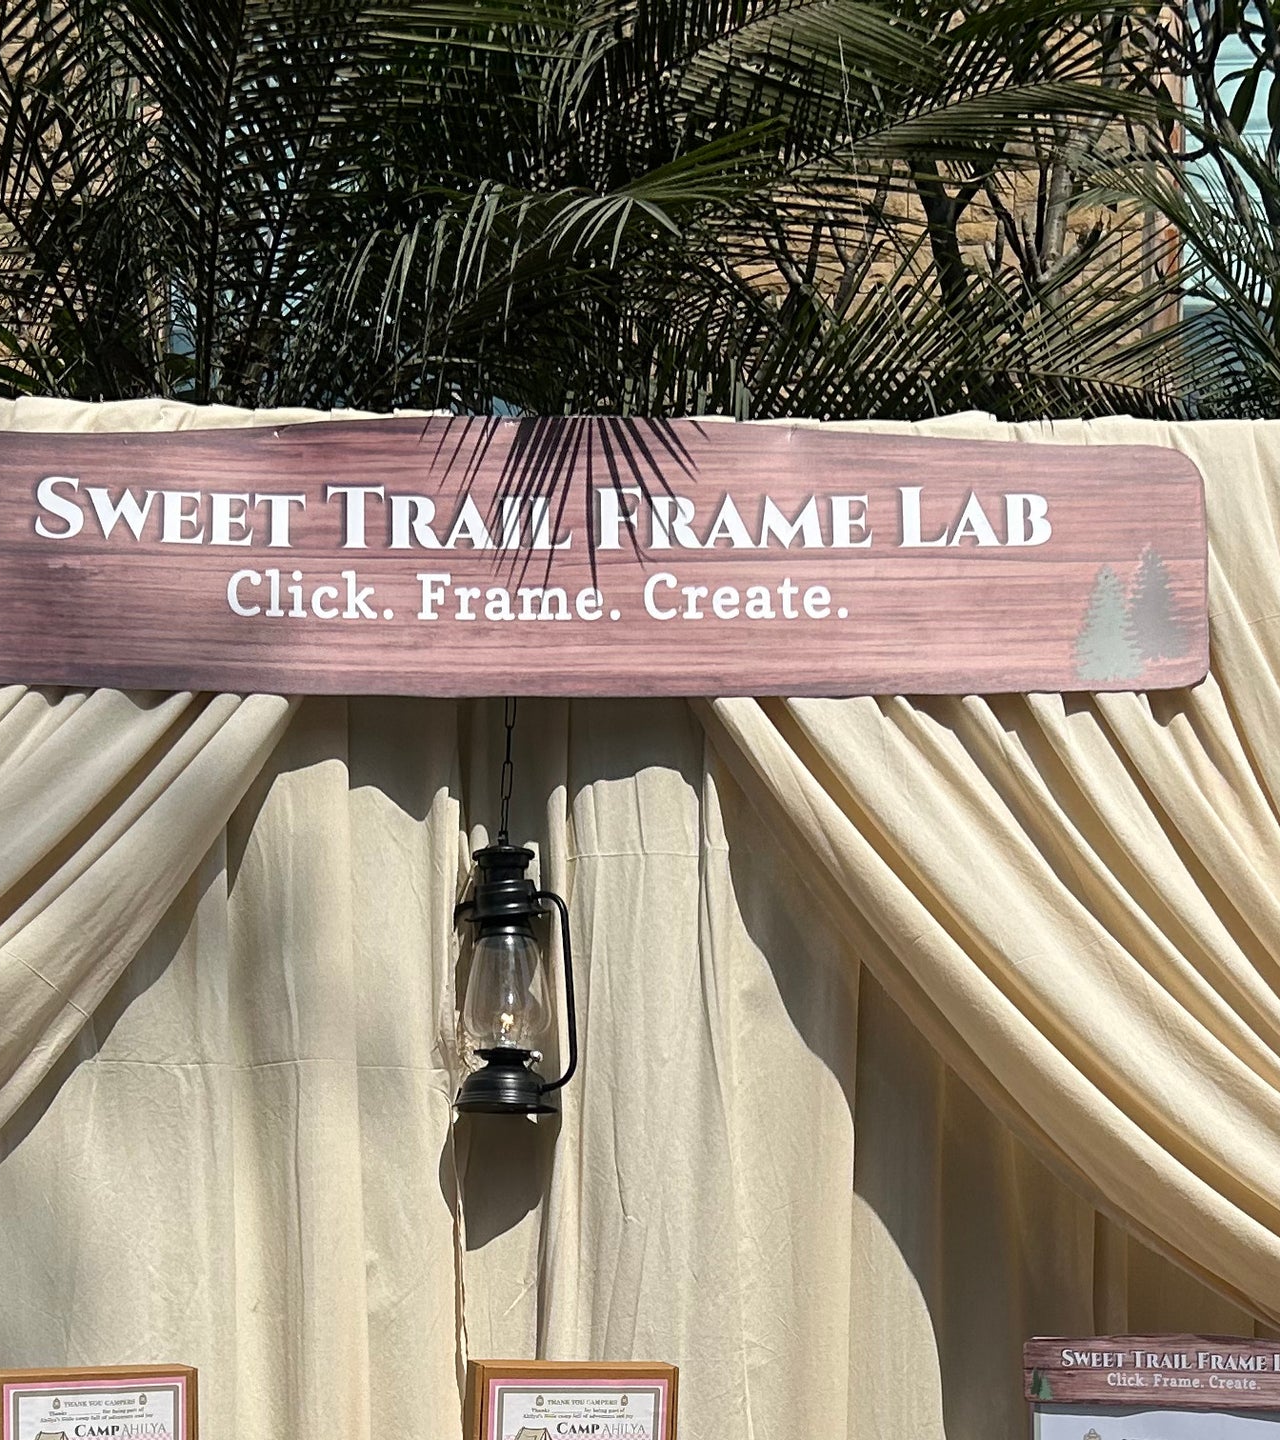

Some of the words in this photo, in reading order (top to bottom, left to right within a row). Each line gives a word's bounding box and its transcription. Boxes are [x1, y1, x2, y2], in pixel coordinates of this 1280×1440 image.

[227, 569, 394, 620] Click.
[417, 572, 620, 621] Frame.
[644, 572, 848, 620] Create.
[1107, 1372, 1148, 1387] Click.
[1154, 1374, 1204, 1388] Frame.
[1209, 1375, 1261, 1390] Create.
[75, 1424, 120, 1437] CAMP
[121, 1423, 166, 1438] AHILYA
[556, 1422, 600, 1434] CAMP
[602, 1422, 645, 1437] AHILYA
